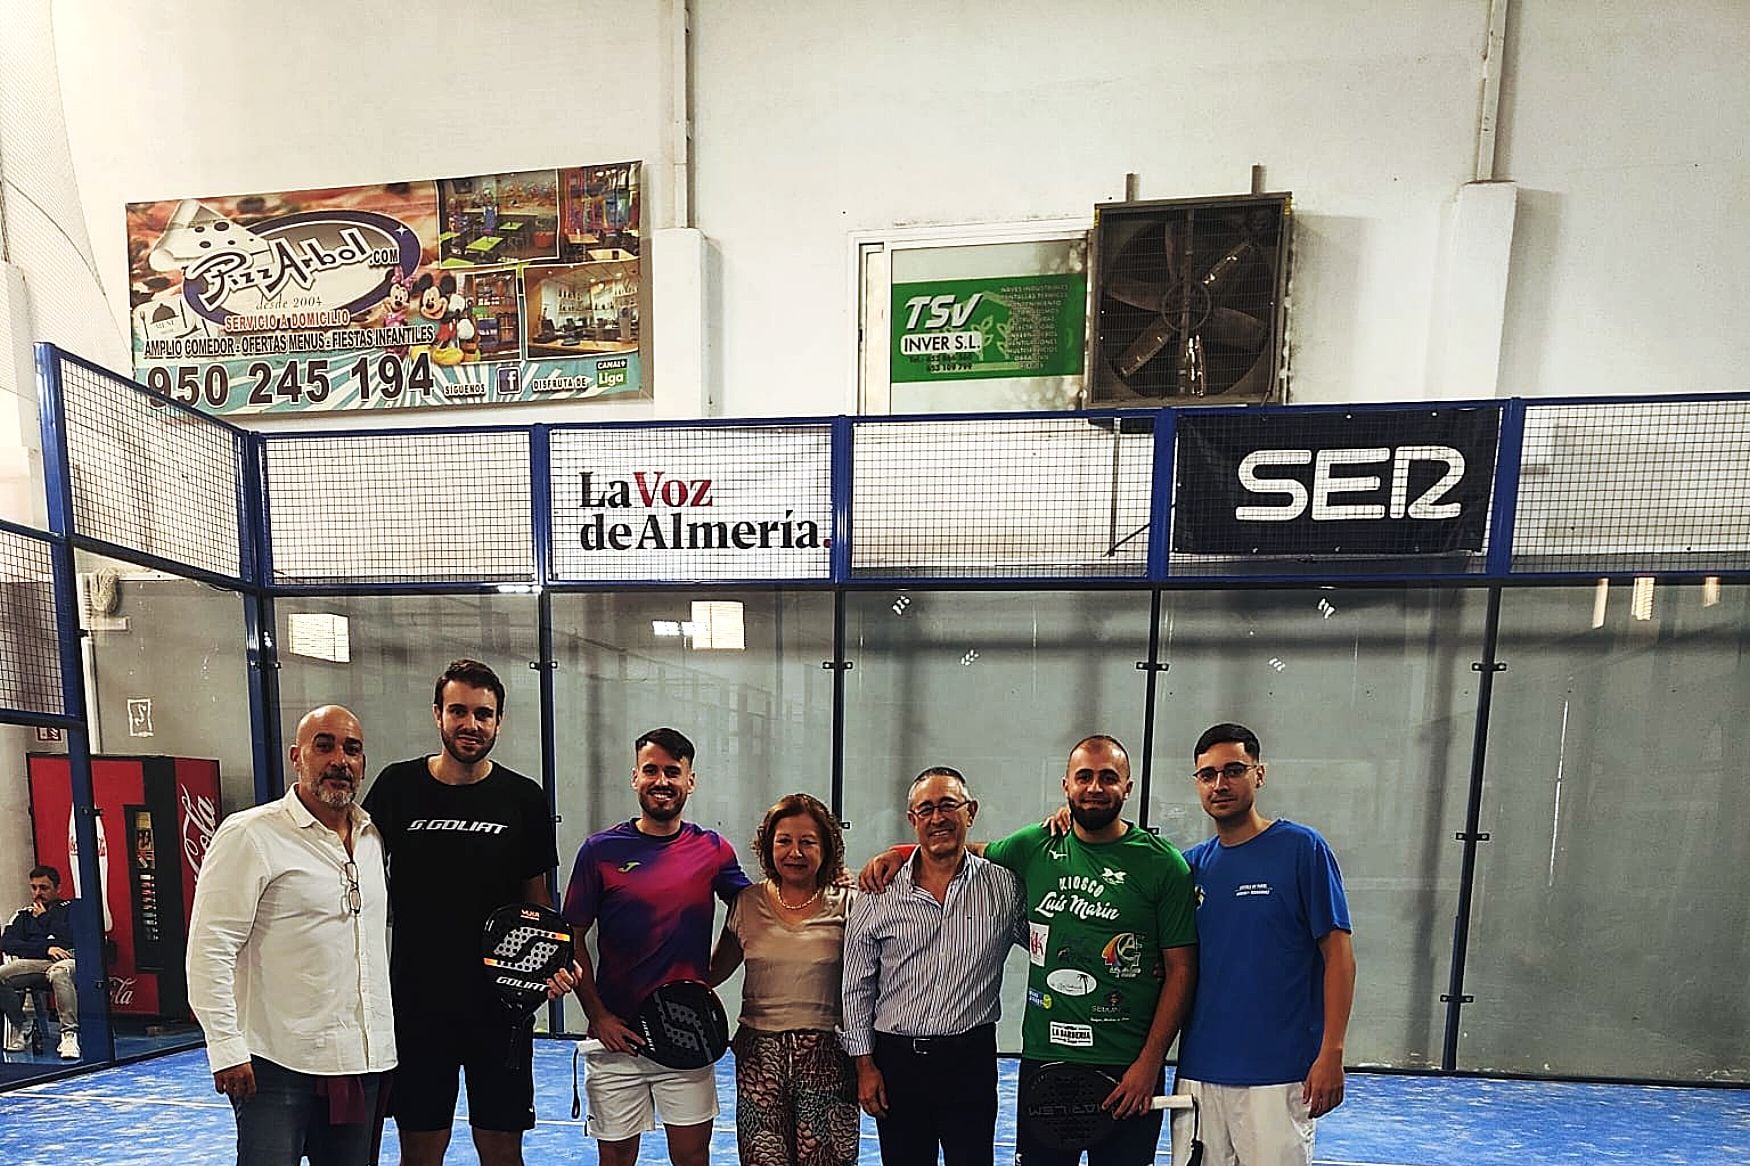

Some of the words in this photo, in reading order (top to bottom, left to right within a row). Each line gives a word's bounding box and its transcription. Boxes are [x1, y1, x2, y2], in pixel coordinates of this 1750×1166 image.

[256, 295, 288, 310] desde
[225, 315, 277, 331] SERVICIO
[280, 315, 288, 328] A
[292, 310, 350, 327] DOMICILIO
[144, 340, 182, 356] AMPLIO
[185, 337, 235, 355] COMEDOR
[242, 335, 287, 352] OFERTAS
[288, 332, 326, 350] MENUS
[333, 329, 373, 348] FIESTAS
[376, 326, 434, 345] INFANTILES
[904, 336, 951, 353] INVER
[955, 335, 981, 350] S.L.
[147, 365, 229, 408] 950
[248, 360, 330, 404] 245
[351, 353, 434, 400] 194
[533, 378, 573, 391] DISFRUTA
[576, 377, 587, 387] DE
[598, 371, 624, 387] Liga
[1235, 446, 1465, 521] SER
[1059, 875, 1105, 898] KIOSCO
[1035, 891, 1068, 918] Luis
[496, 976, 550, 991] GOLIAT
